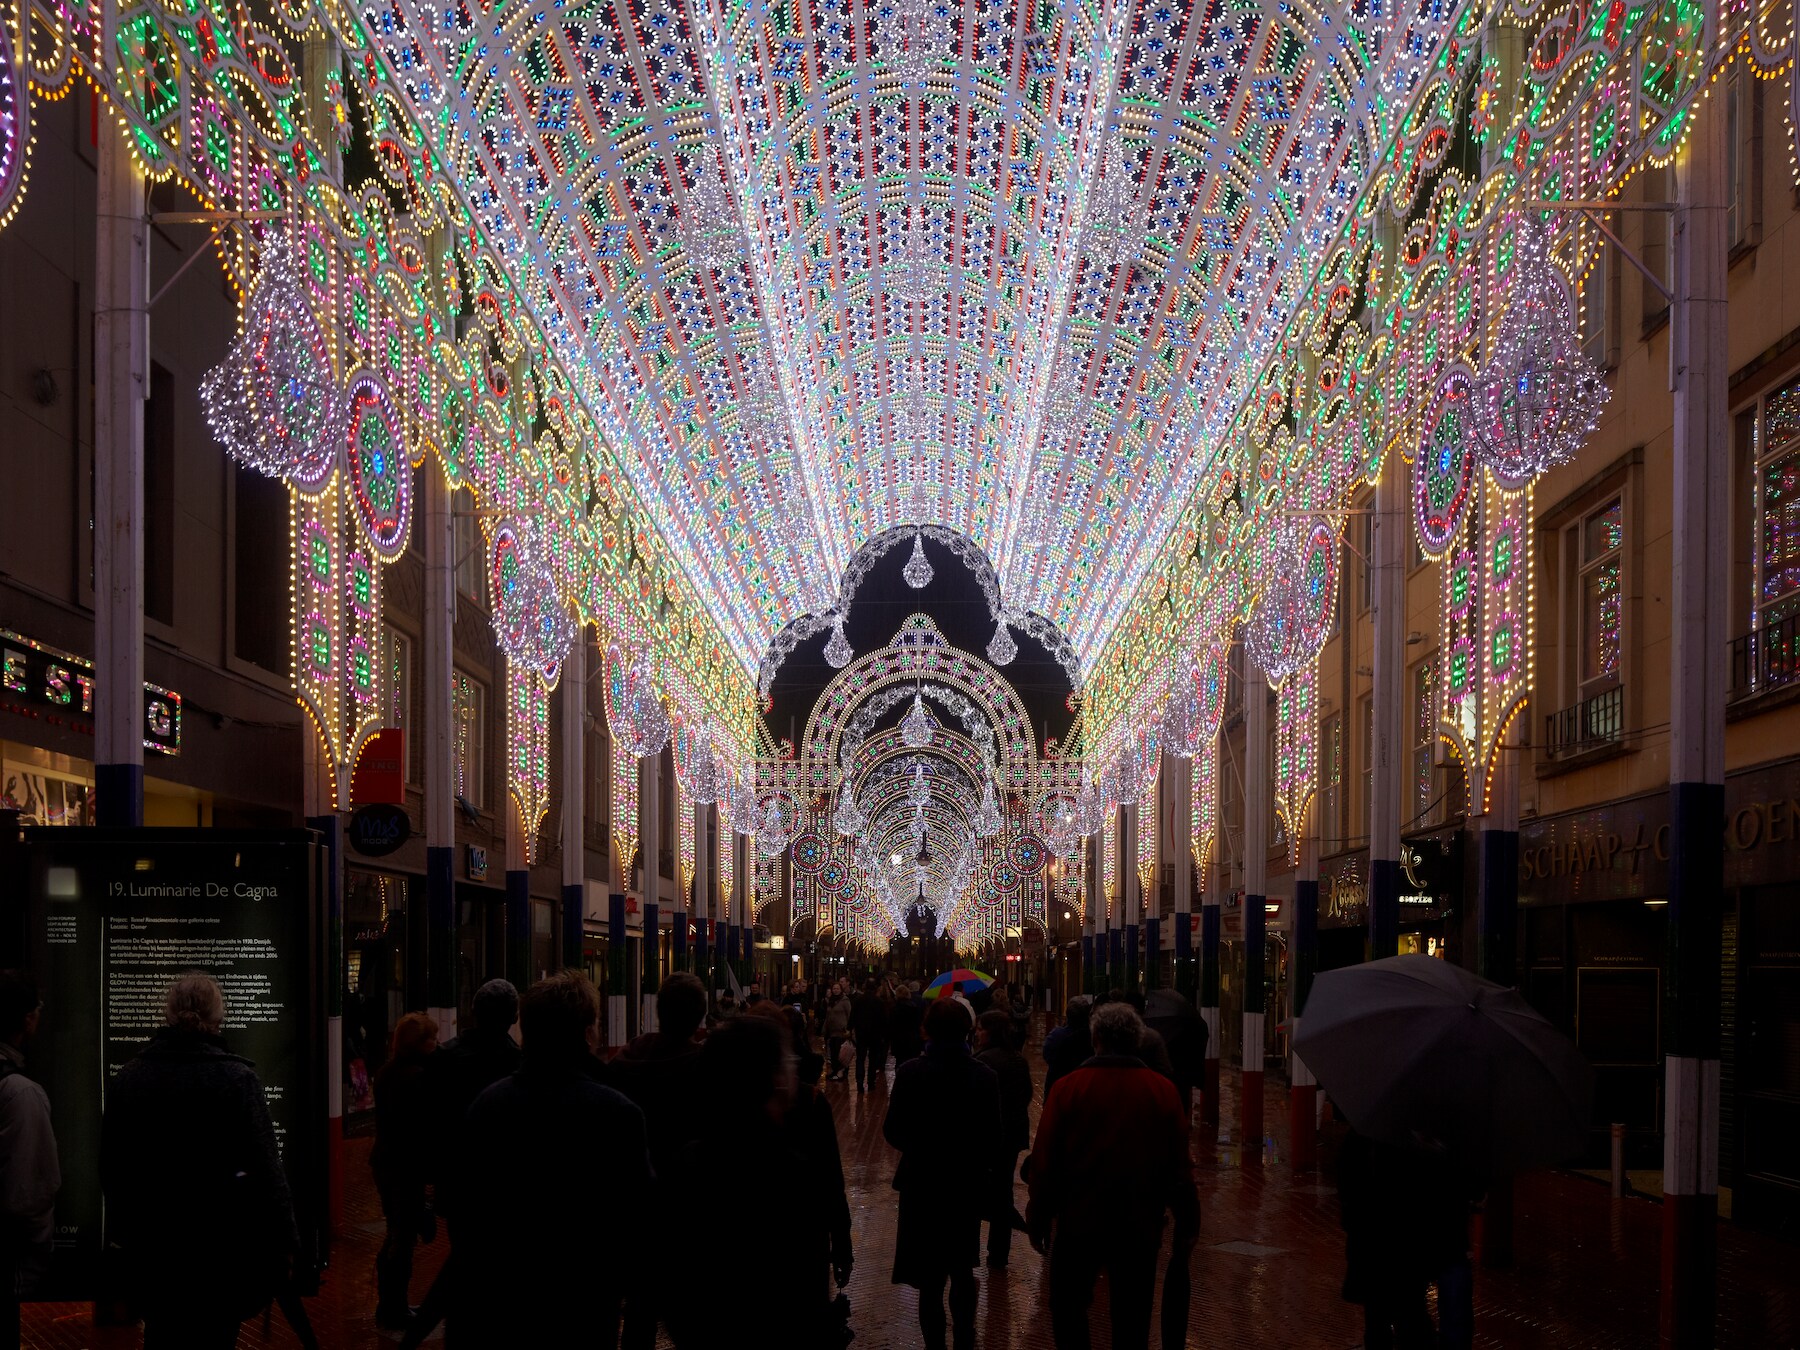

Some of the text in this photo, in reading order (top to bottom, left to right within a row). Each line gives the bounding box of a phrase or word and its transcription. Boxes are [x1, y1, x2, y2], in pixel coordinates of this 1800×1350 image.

[1522, 834, 1622, 882] SCHAAP
[109, 882, 278, 901] 19. Luminarie De Cagna
